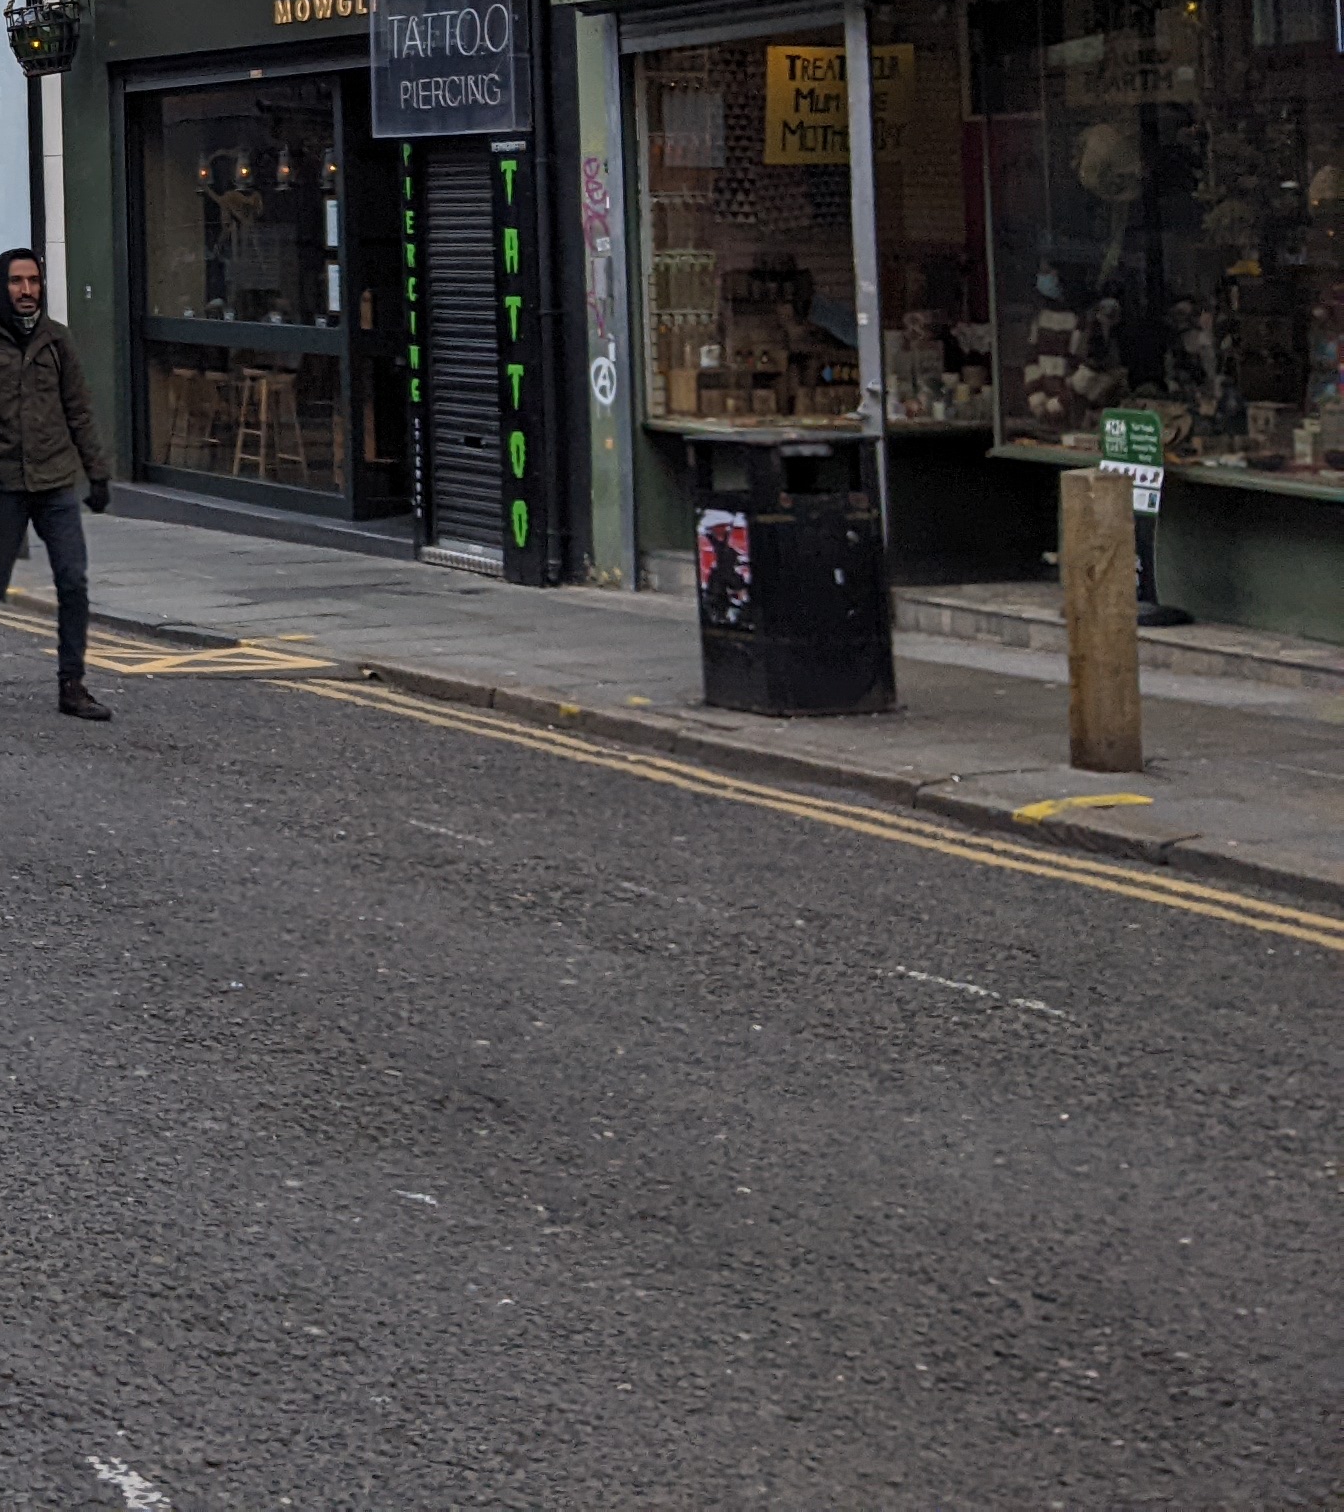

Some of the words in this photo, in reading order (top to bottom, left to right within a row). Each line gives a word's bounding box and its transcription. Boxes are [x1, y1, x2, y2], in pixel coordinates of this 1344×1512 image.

[387, 3, 509, 59] TATTOO
[400, 73, 501, 110] PIERCING
[500, 160, 528, 548] TATTOO
